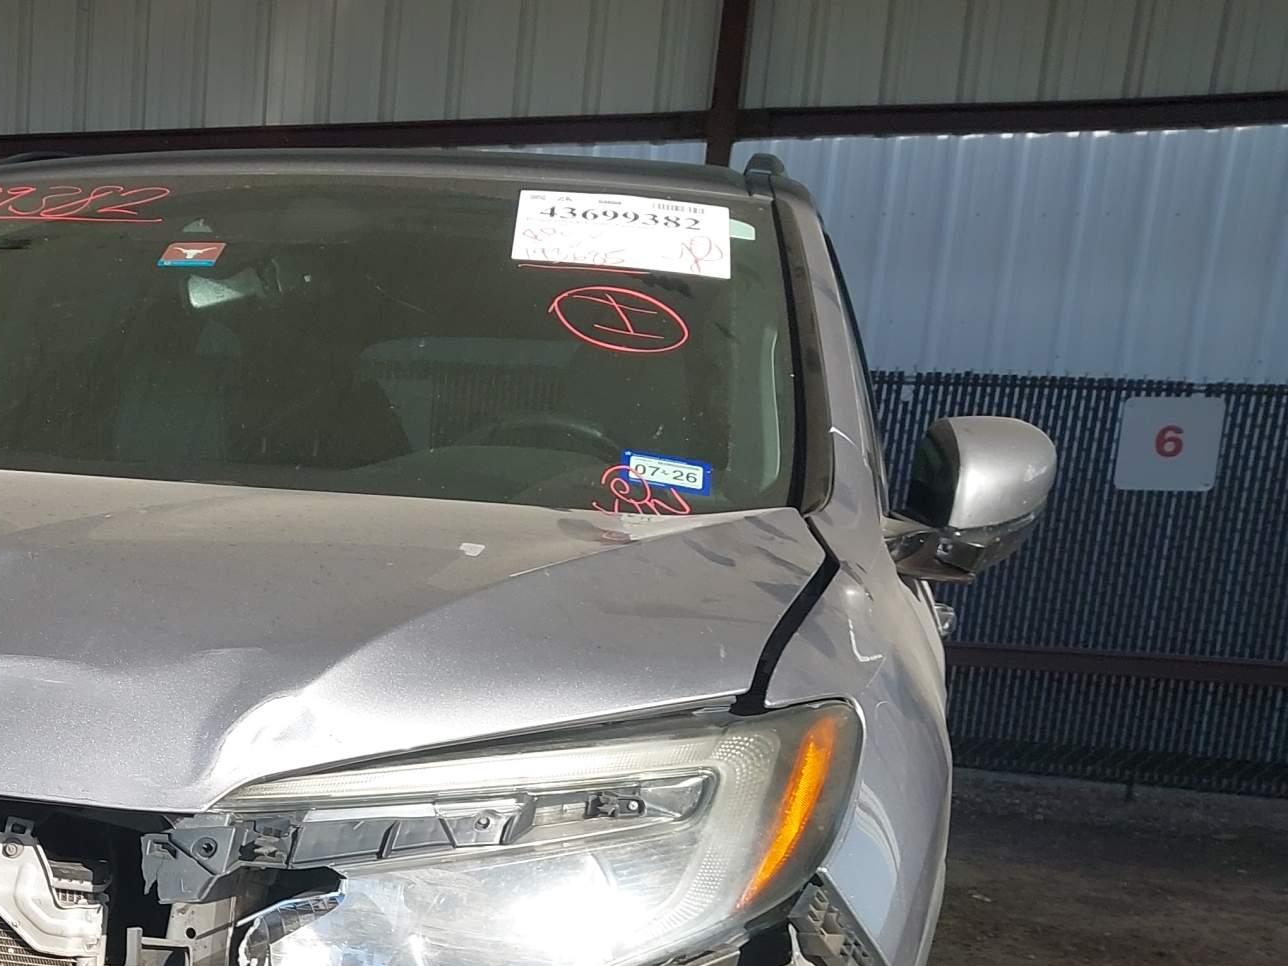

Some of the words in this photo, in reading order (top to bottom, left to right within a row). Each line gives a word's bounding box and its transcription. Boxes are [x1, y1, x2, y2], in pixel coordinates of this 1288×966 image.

[539, 205, 702, 231] 43699382
[1155, 425, 1183, 457] 6
[634, 463, 661, 477] 07
[672, 469, 698, 483] 26
